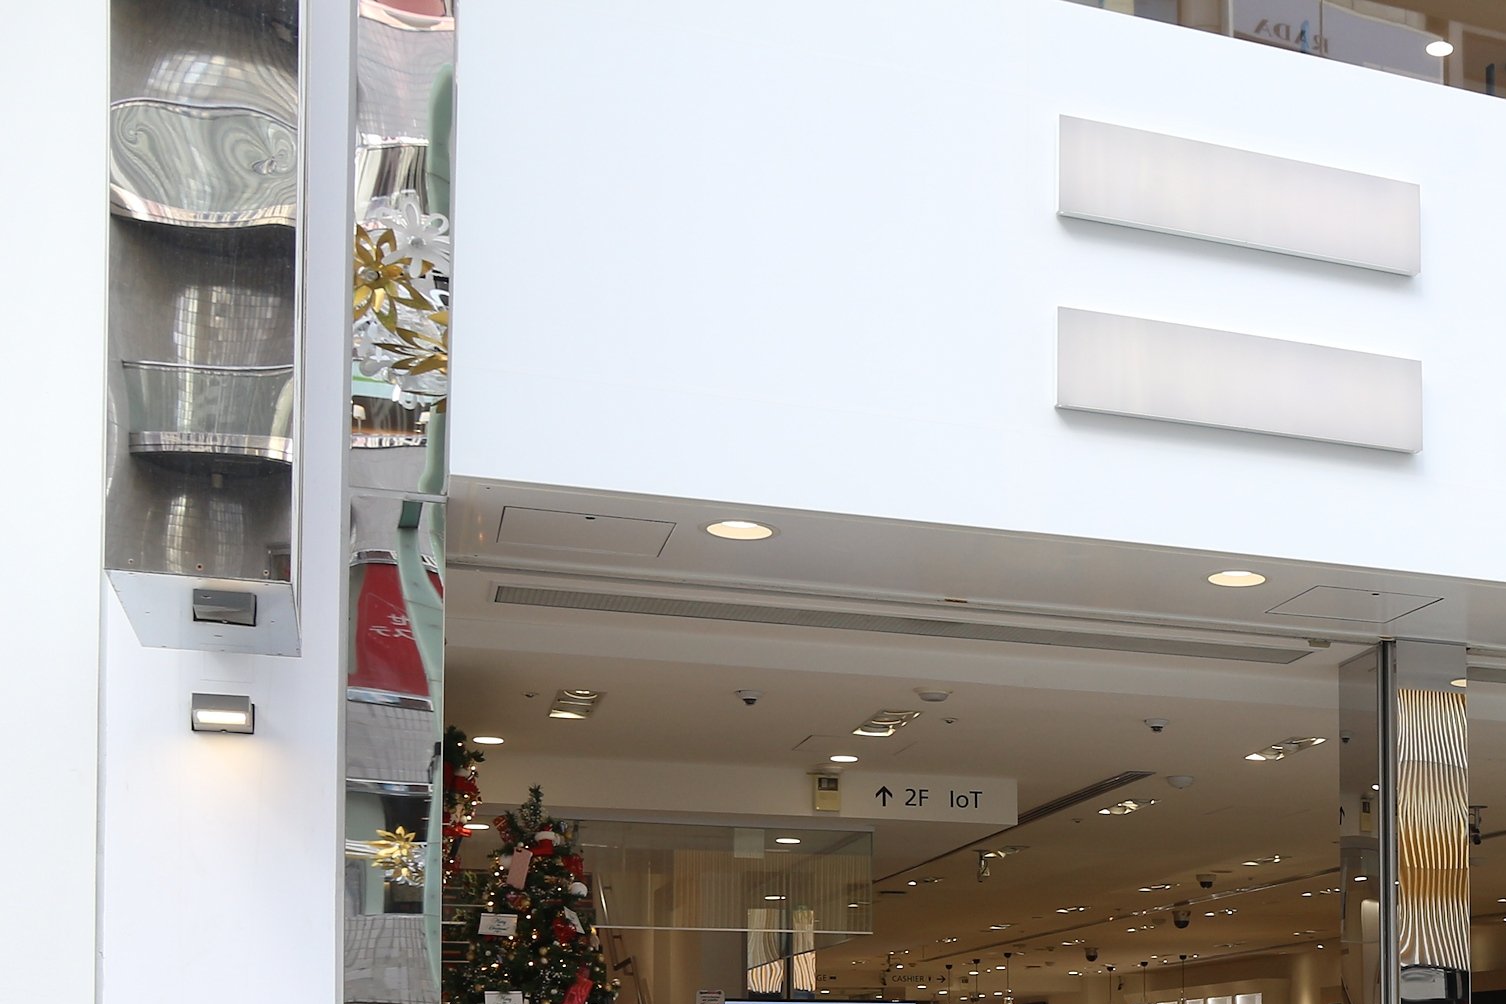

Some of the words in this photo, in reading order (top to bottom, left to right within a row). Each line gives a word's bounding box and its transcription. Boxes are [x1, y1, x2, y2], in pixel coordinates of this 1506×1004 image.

[905, 788, 929, 807] 2F
[950, 790, 983, 809] IoT
[892, 975, 925, 983] CASHIER
